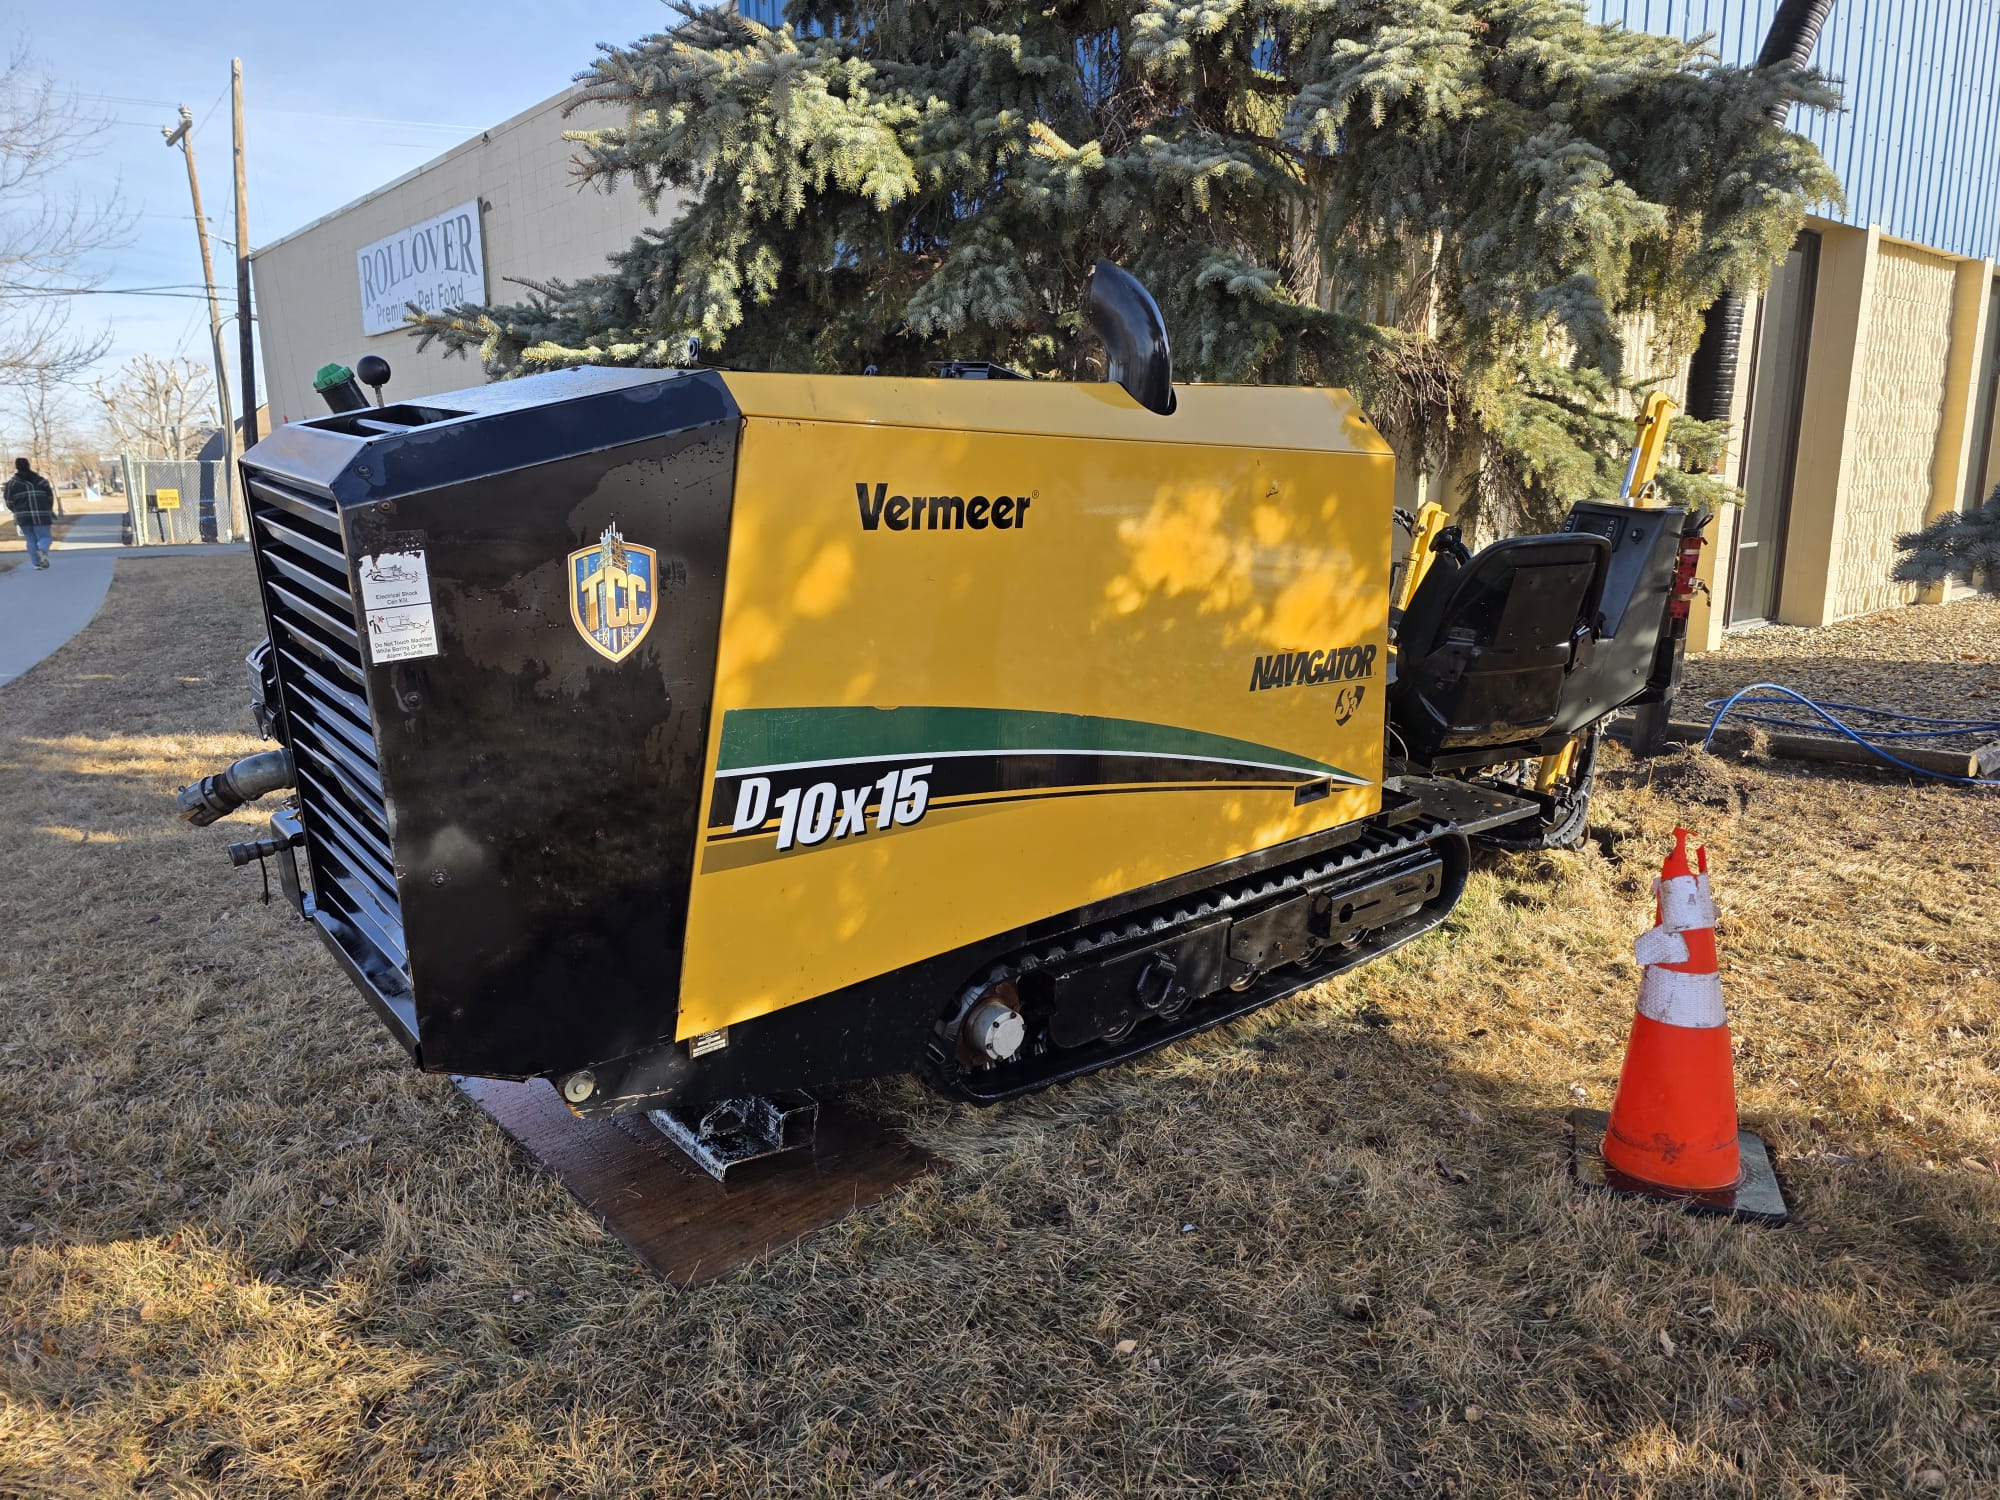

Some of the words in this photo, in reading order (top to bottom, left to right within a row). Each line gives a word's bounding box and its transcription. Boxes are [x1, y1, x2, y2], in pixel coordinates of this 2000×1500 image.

[361, 214, 478, 309] ROLLOVER
[418, 287, 435, 312] Pet
[438, 276, 465, 309] Food
[855, 482, 1031, 531] Vermeer
[581, 565, 648, 632] TCC
[1249, 644, 1377, 692] NAVIGATOR
